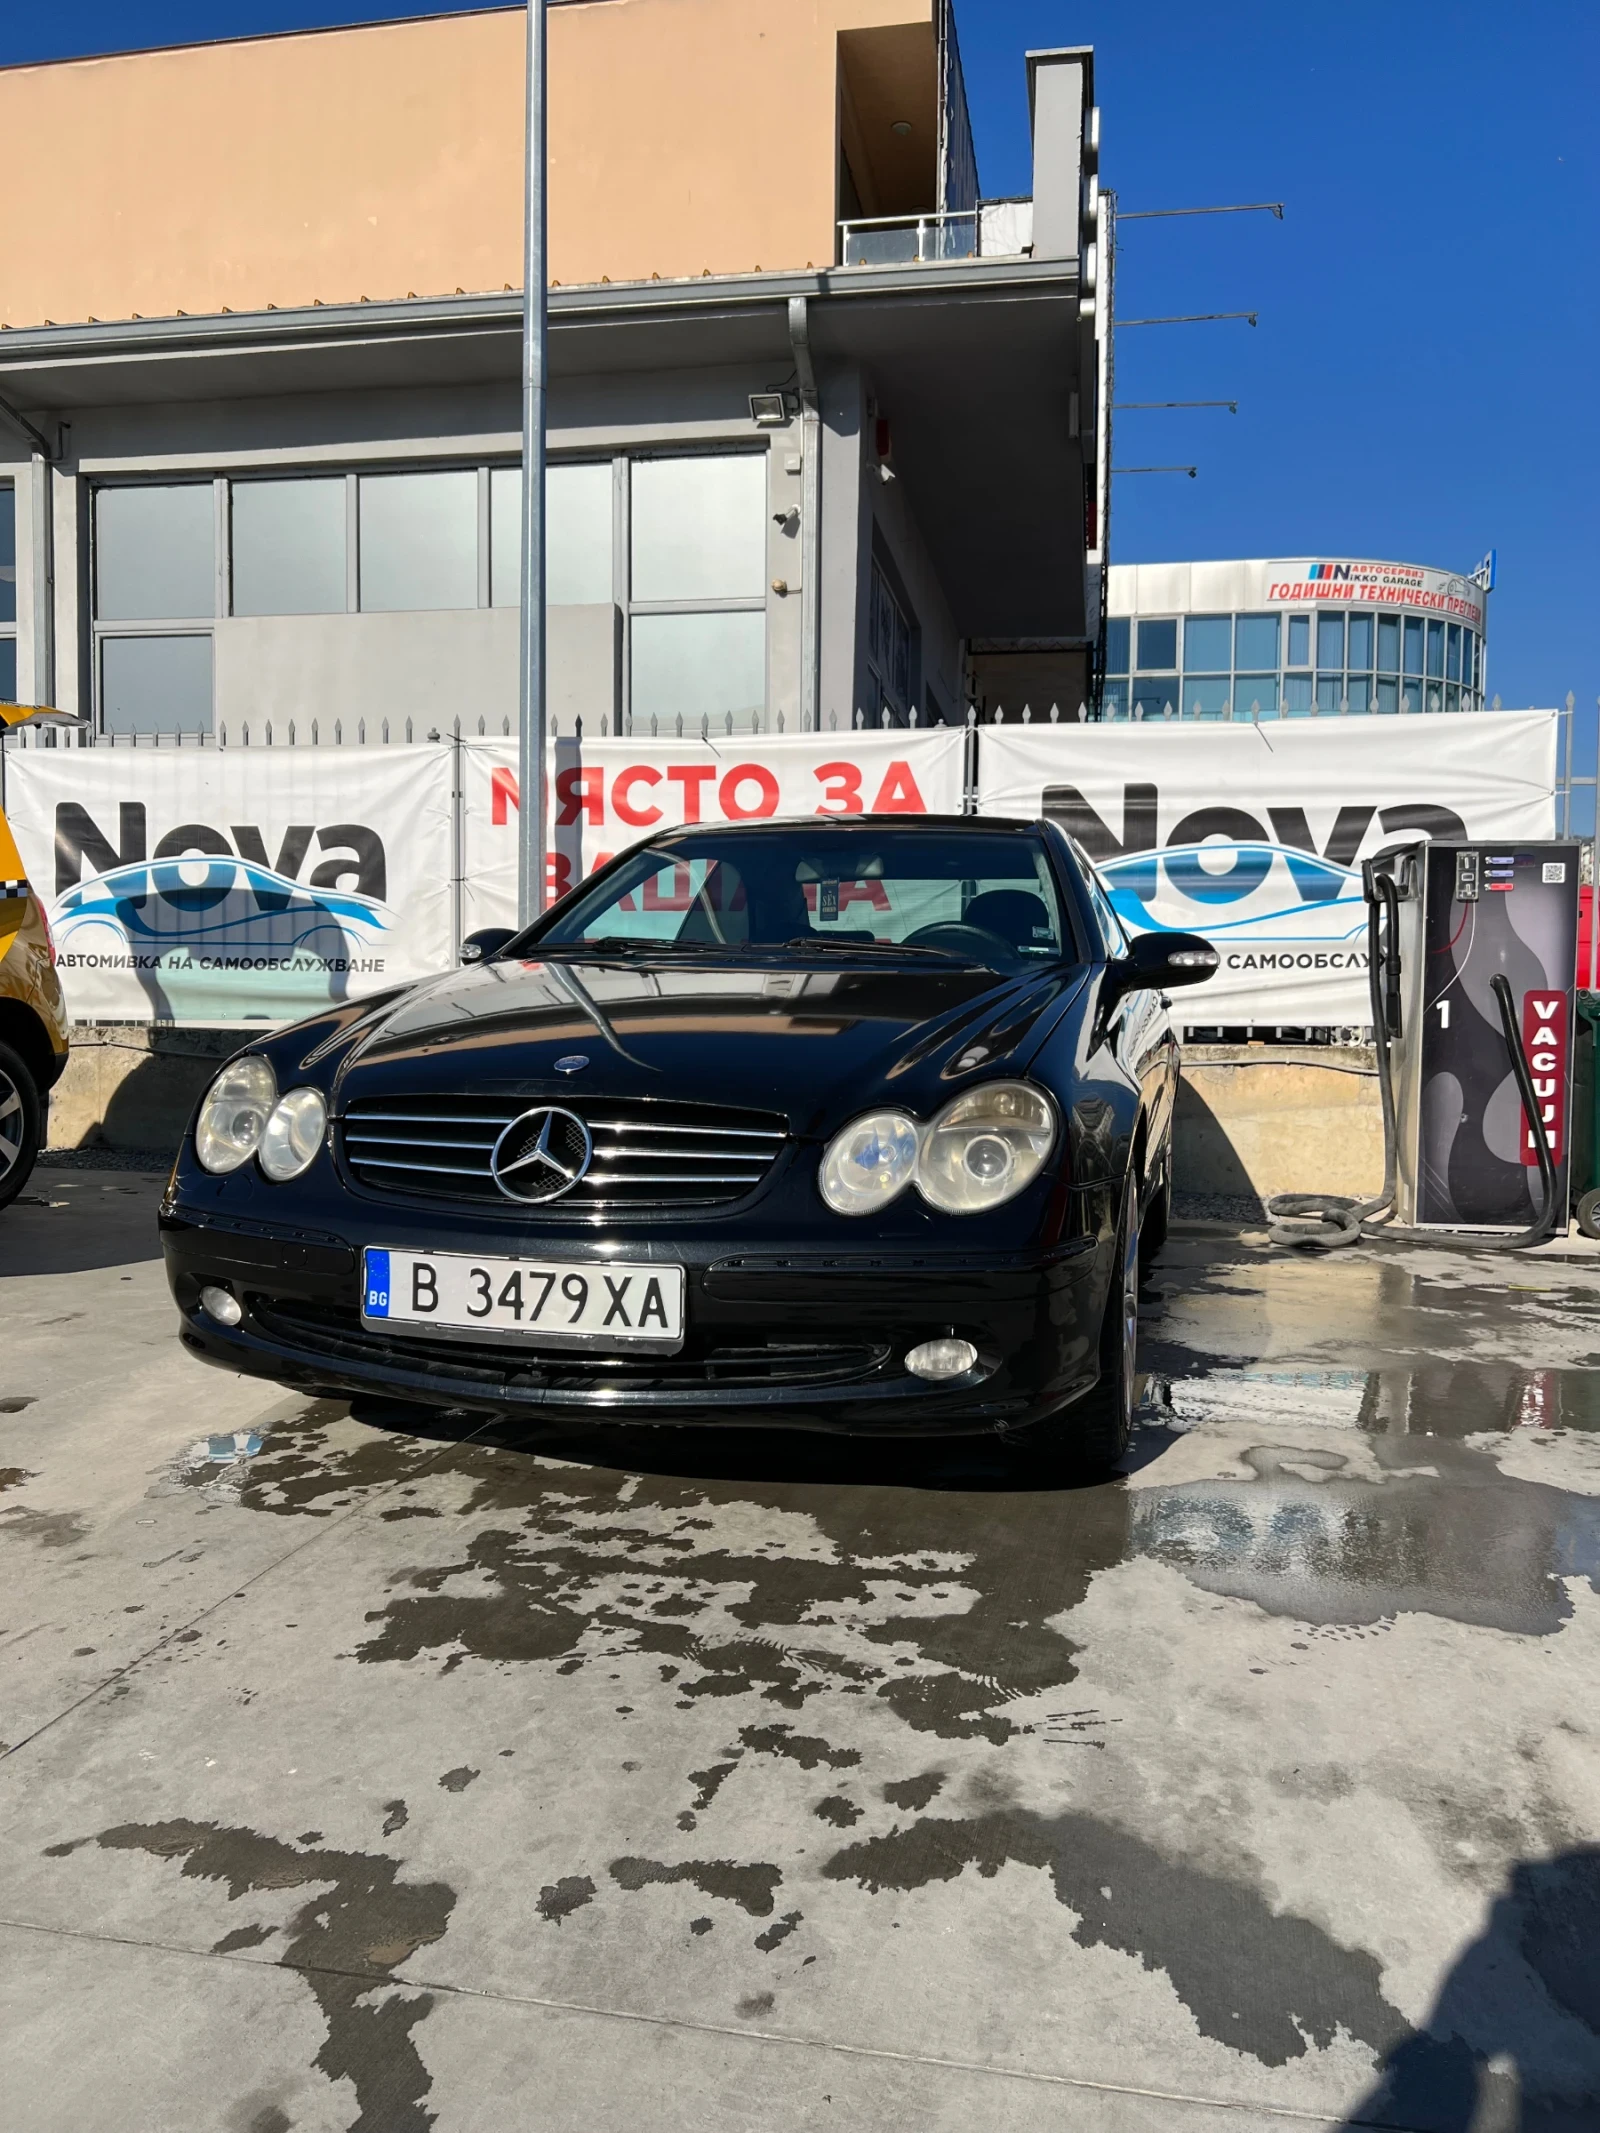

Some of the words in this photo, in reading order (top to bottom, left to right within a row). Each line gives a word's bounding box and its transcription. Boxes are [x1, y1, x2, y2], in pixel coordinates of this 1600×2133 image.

[1352, 565, 1424, 578] АВТОСЕРВИЗ
[1383, 576, 1423, 587] GARAGE
[1269, 583, 1354, 600] ГОДИШНИ
[1359, 585, 1445, 608] ТЕХНИЧЕСКИ
[813, 761, 927, 814] ЗА
[55, 801, 387, 911] Nova
[1041, 783, 1468, 903] Nova
[56, 954, 162, 969] АВТОМИВКА
[168, 956, 193, 970] НА
[200, 955, 385, 972] САМООБСЛУЖВАНЕ
[1436, 1000, 1450, 1029] 1
[369, 1290, 387, 1307] BG
[412, 1262, 439, 1312] B
[466, 1268, 589, 1323] 3479
[602, 1274, 669, 1328] XA
